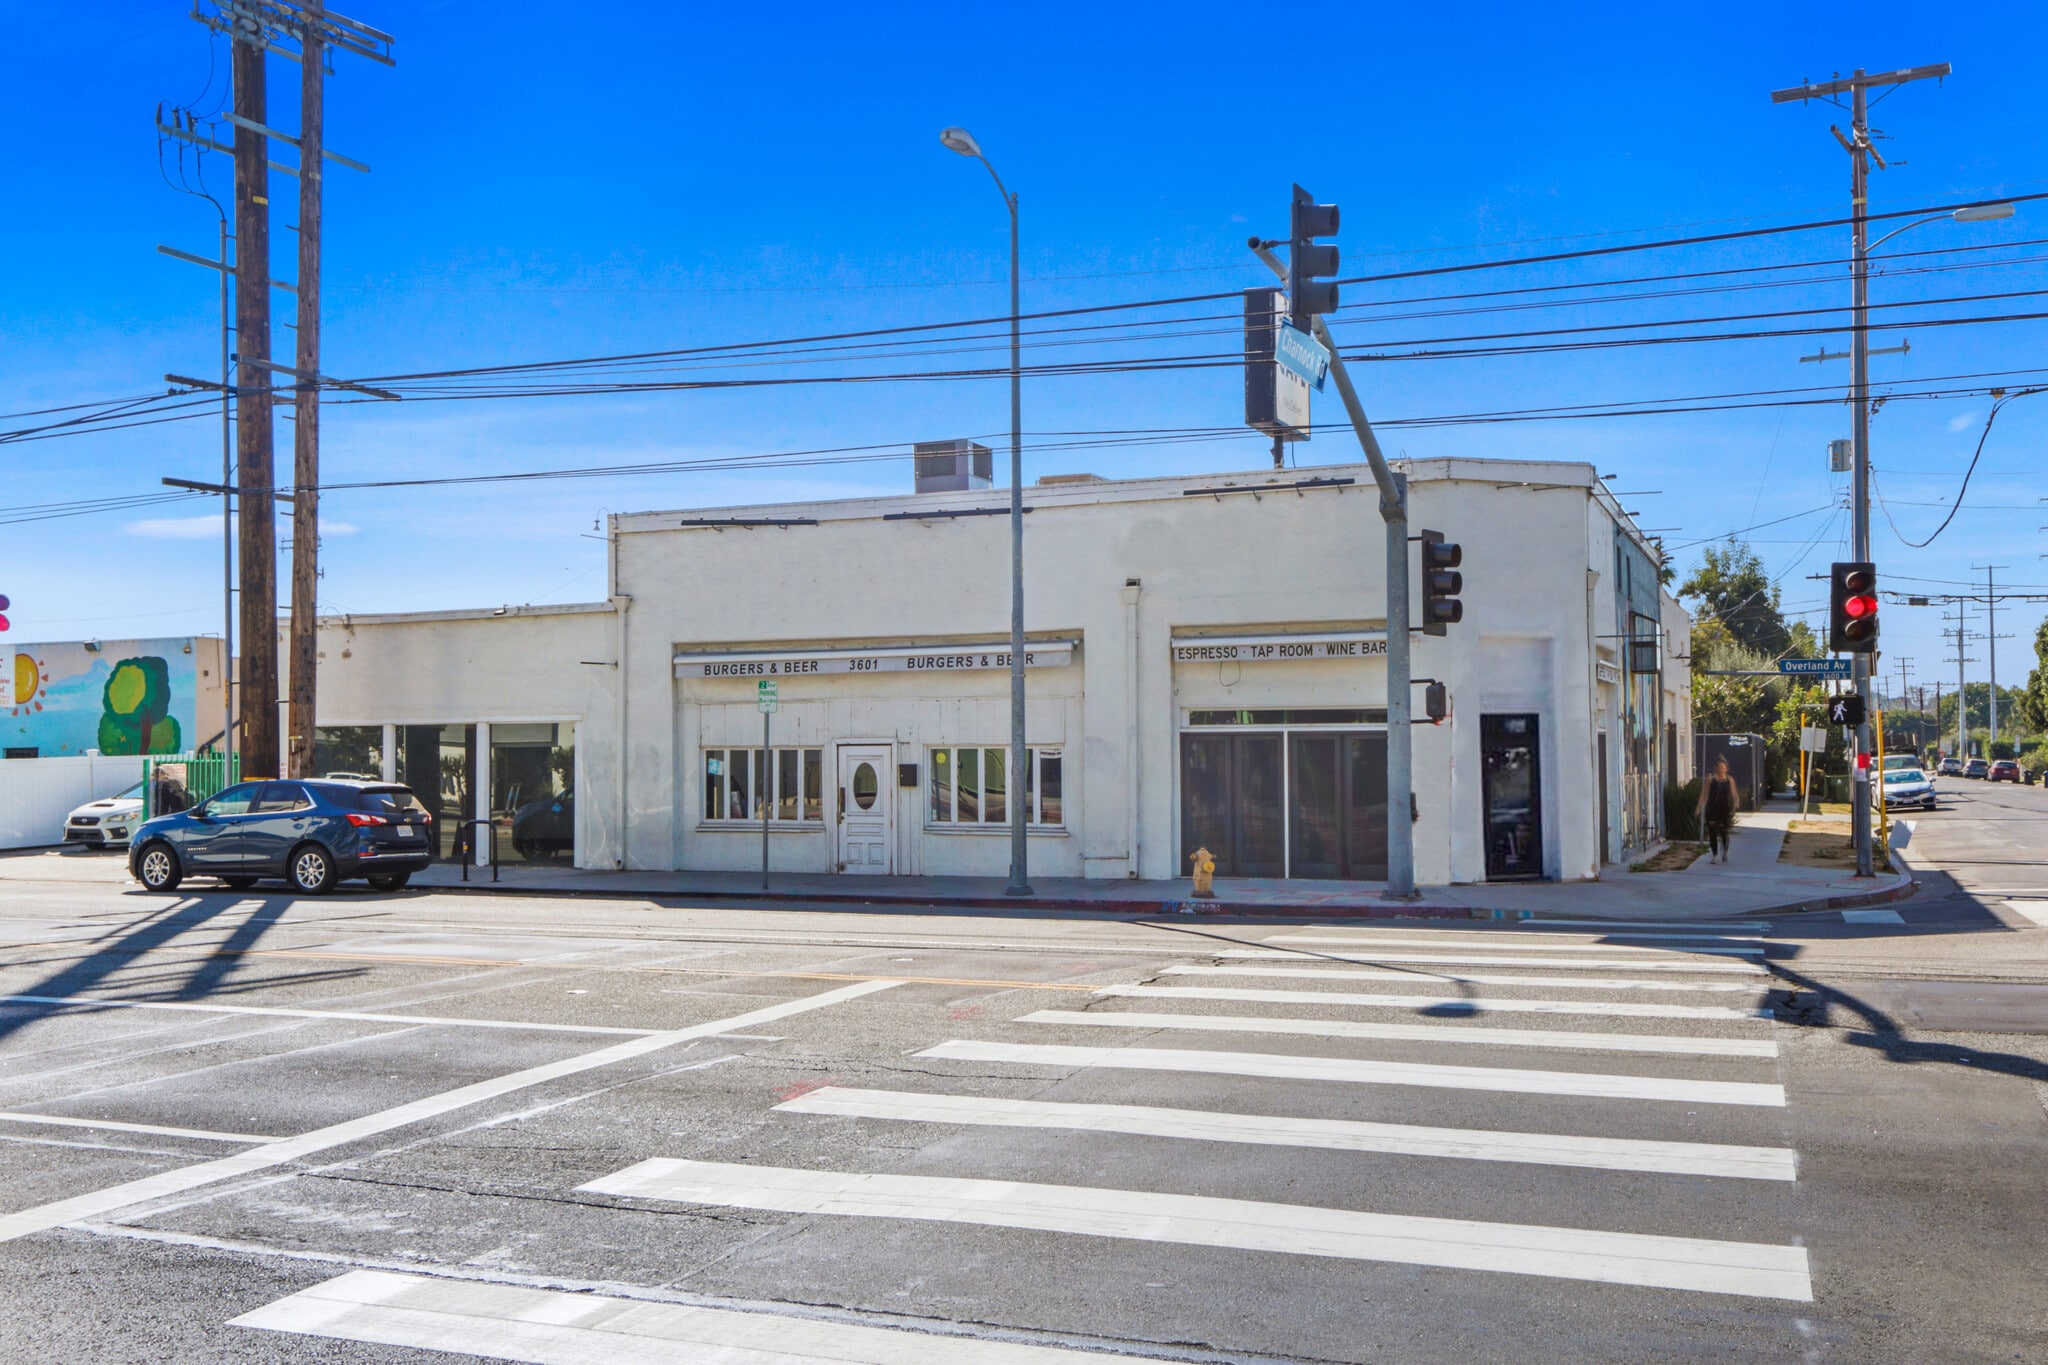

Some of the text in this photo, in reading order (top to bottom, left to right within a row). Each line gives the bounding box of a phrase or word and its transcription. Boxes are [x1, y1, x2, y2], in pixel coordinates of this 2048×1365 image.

[1281, 328, 1315, 370] Charnock
[1315, 355, 1325, 379] Rd
[1178, 641, 1387, 660] ESPRESSO TAP ROOM WINE BAR
[704, 660, 819, 676] BURGERS & BEER
[849, 659, 878, 671] 3601
[907, 653, 1034, 669] BURGERS & BER
[1785, 661, 1846, 671] Overland Av
